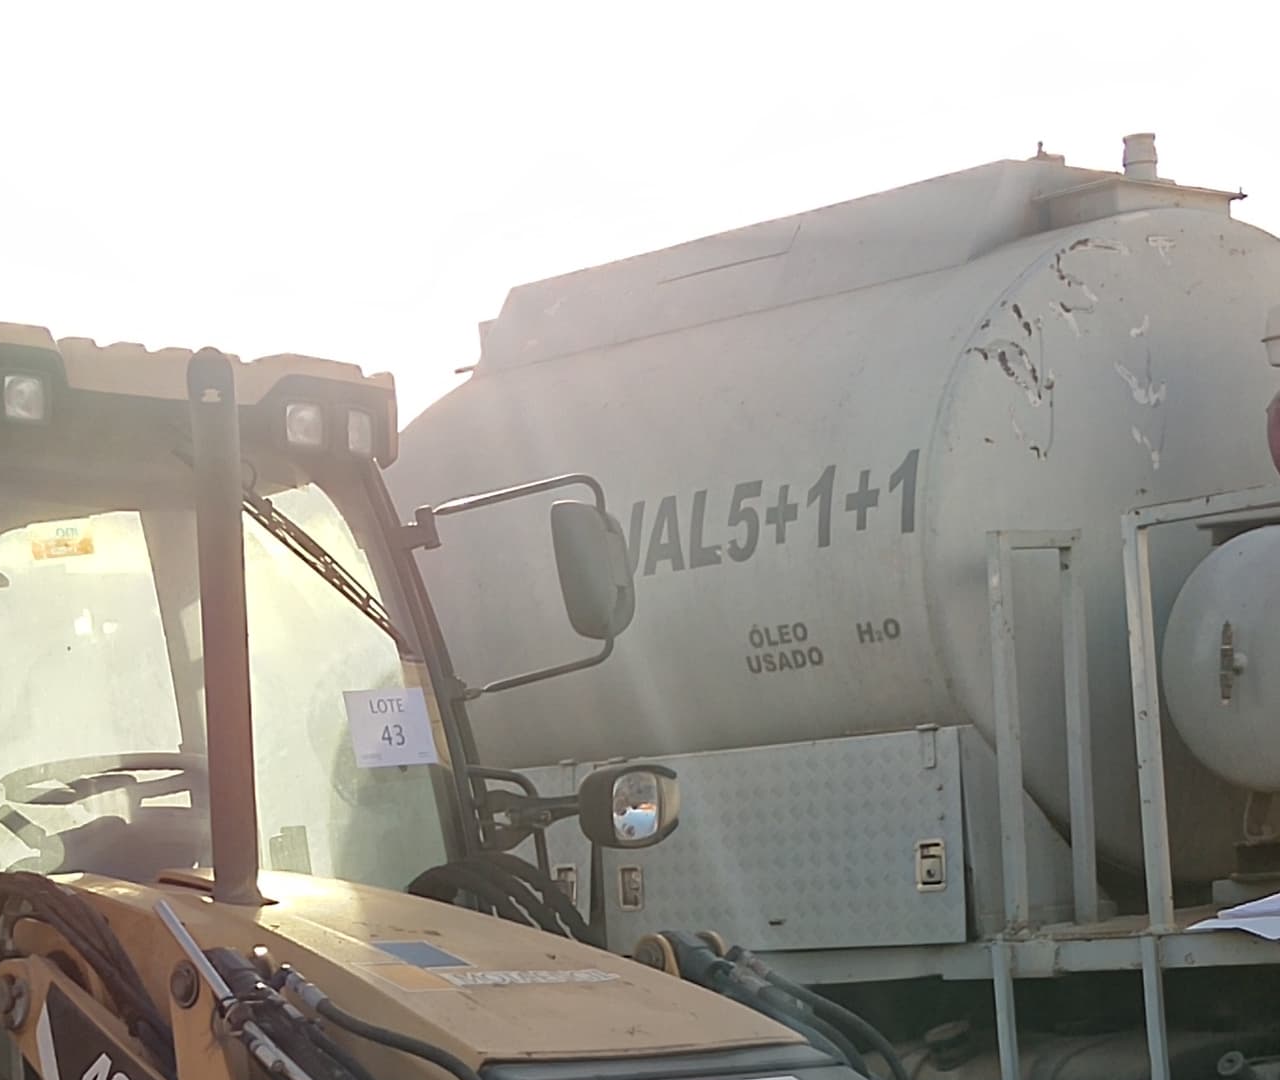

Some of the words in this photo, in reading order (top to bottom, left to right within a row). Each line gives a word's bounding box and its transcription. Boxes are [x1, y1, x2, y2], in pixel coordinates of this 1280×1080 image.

[748, 622, 808, 649] ÓLEO
[746, 646, 824, 674] USADO
[368, 698, 405, 714] LOTE
[381, 724, 406, 746] 43
